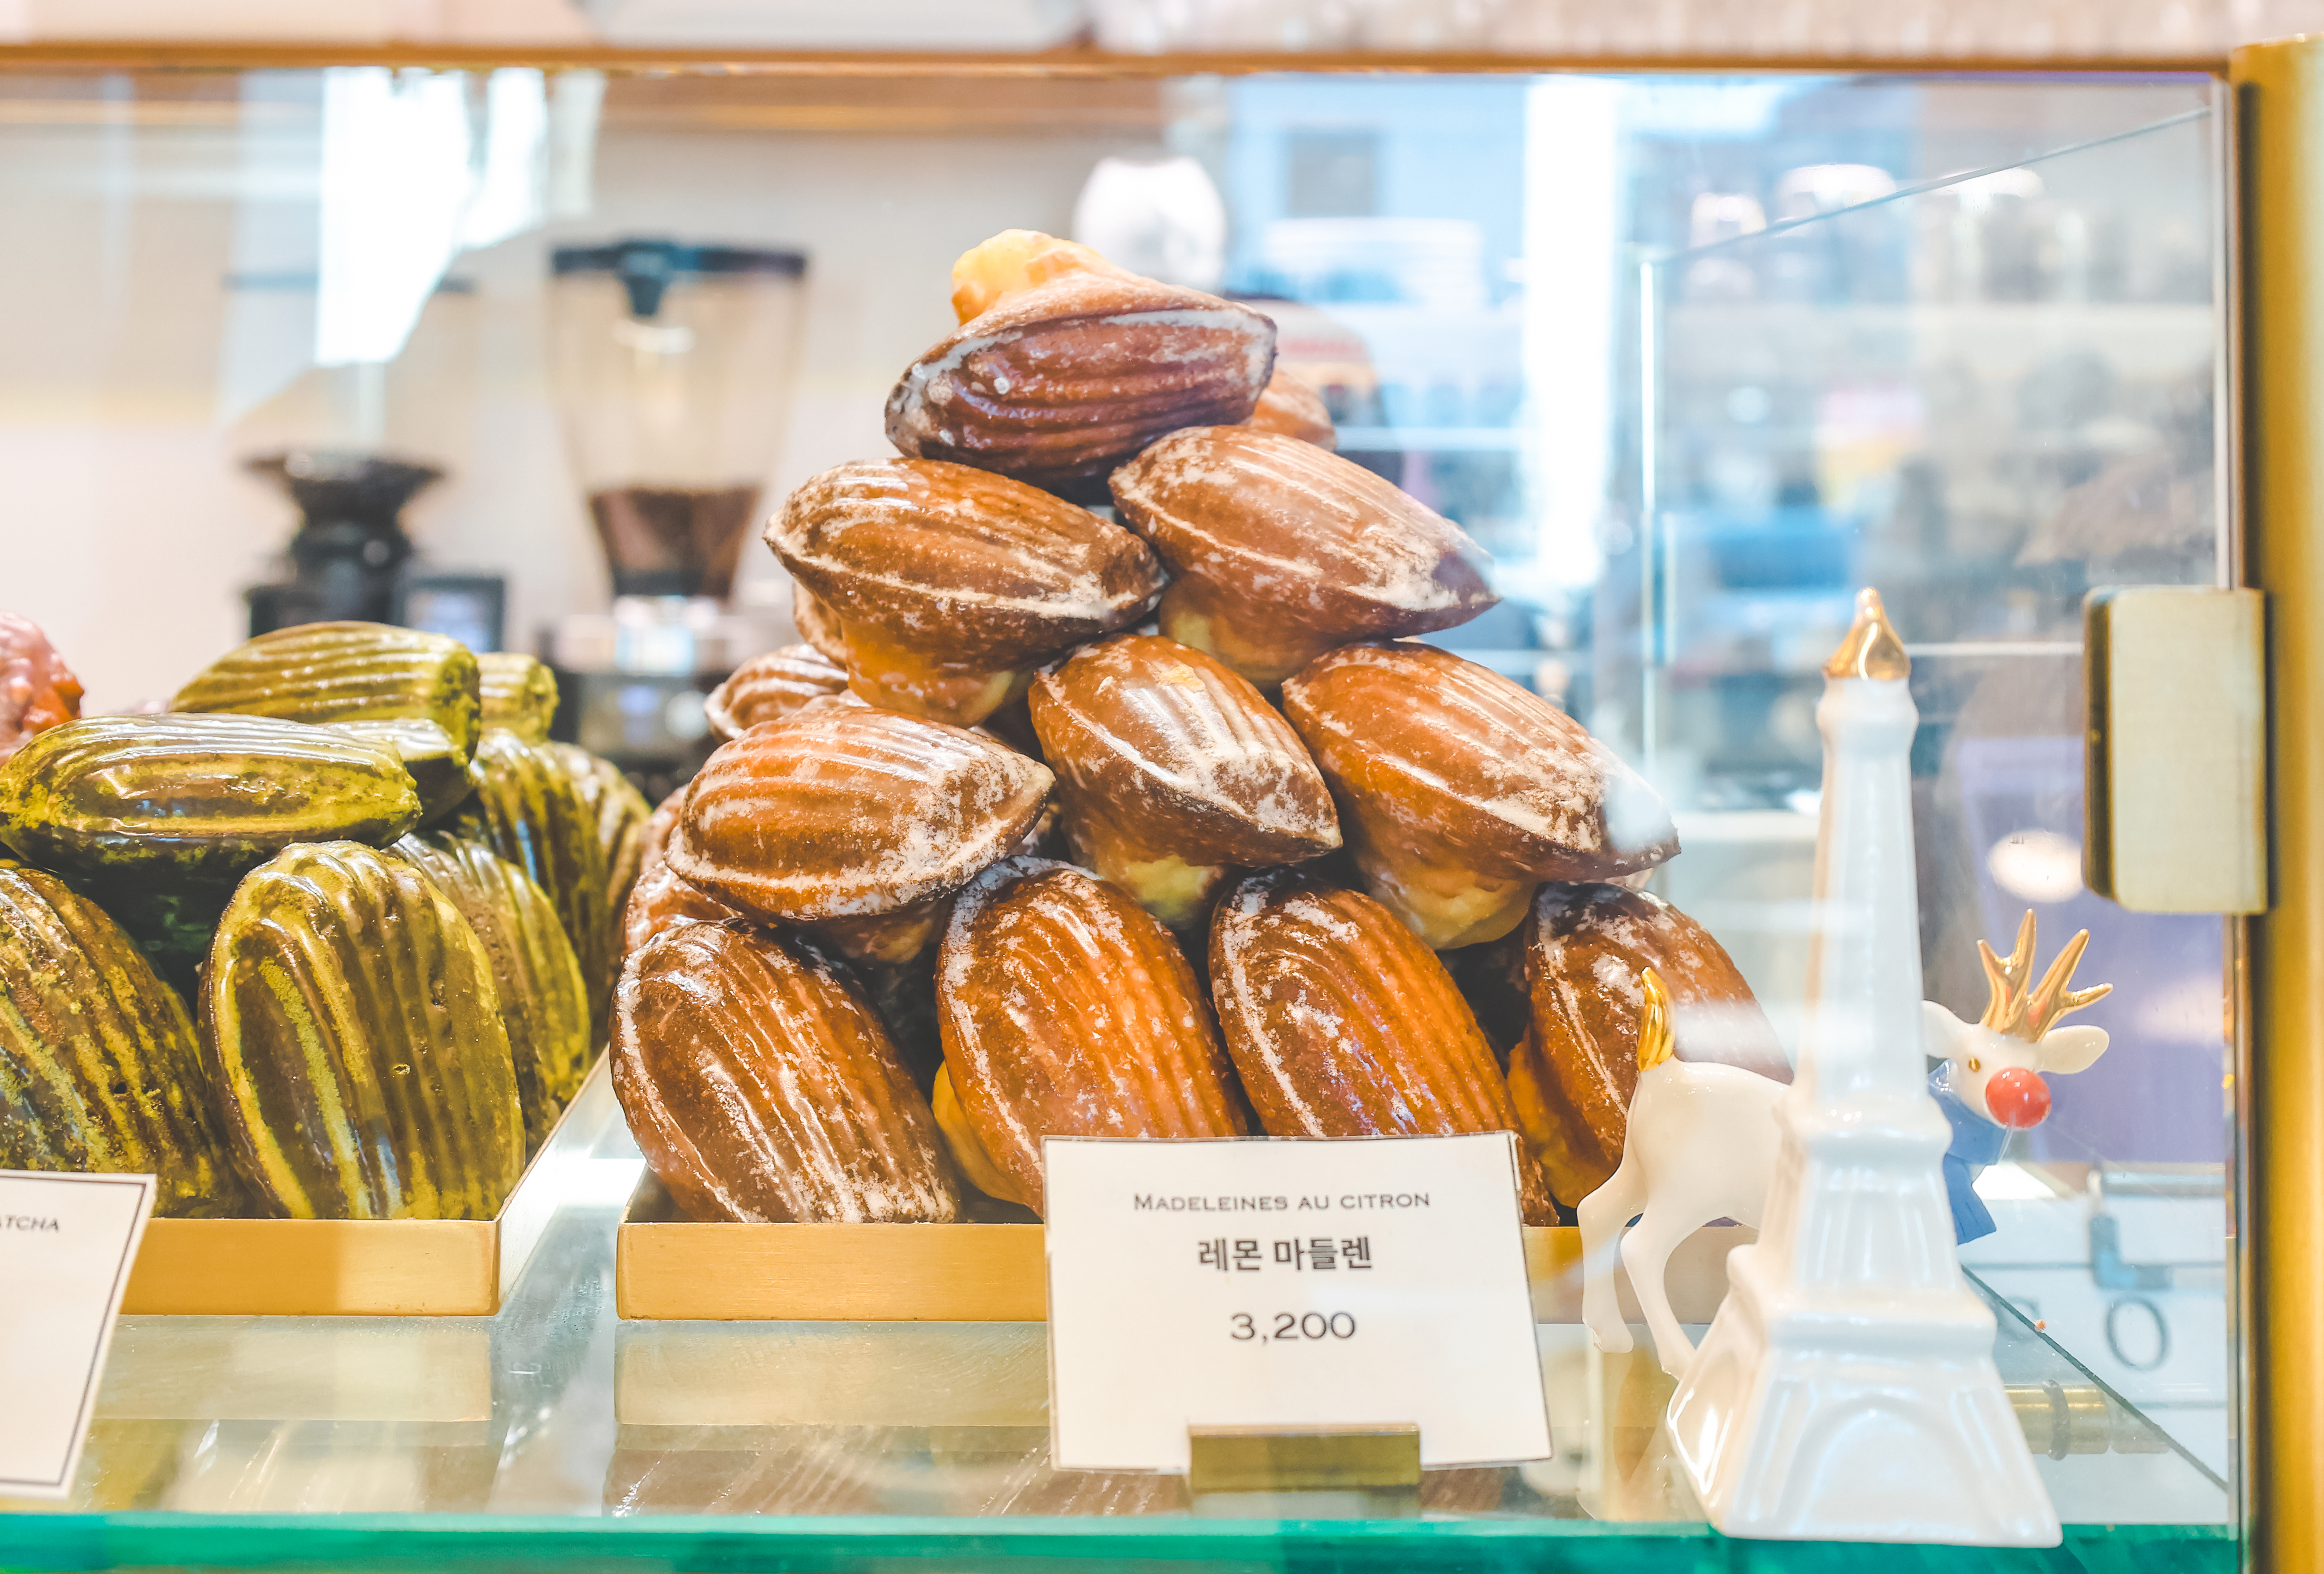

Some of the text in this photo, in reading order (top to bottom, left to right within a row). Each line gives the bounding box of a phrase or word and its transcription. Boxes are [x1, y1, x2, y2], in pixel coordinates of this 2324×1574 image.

[1298, 1196, 1330, 1210] AU
[1340, 1193, 1430, 1210] CITRON
[0, 1215, 59, 1232] TCHA
[1198, 1236, 1372, 1271] 레몬 마들렌
[1230, 1312, 1357, 1345] 3,200
